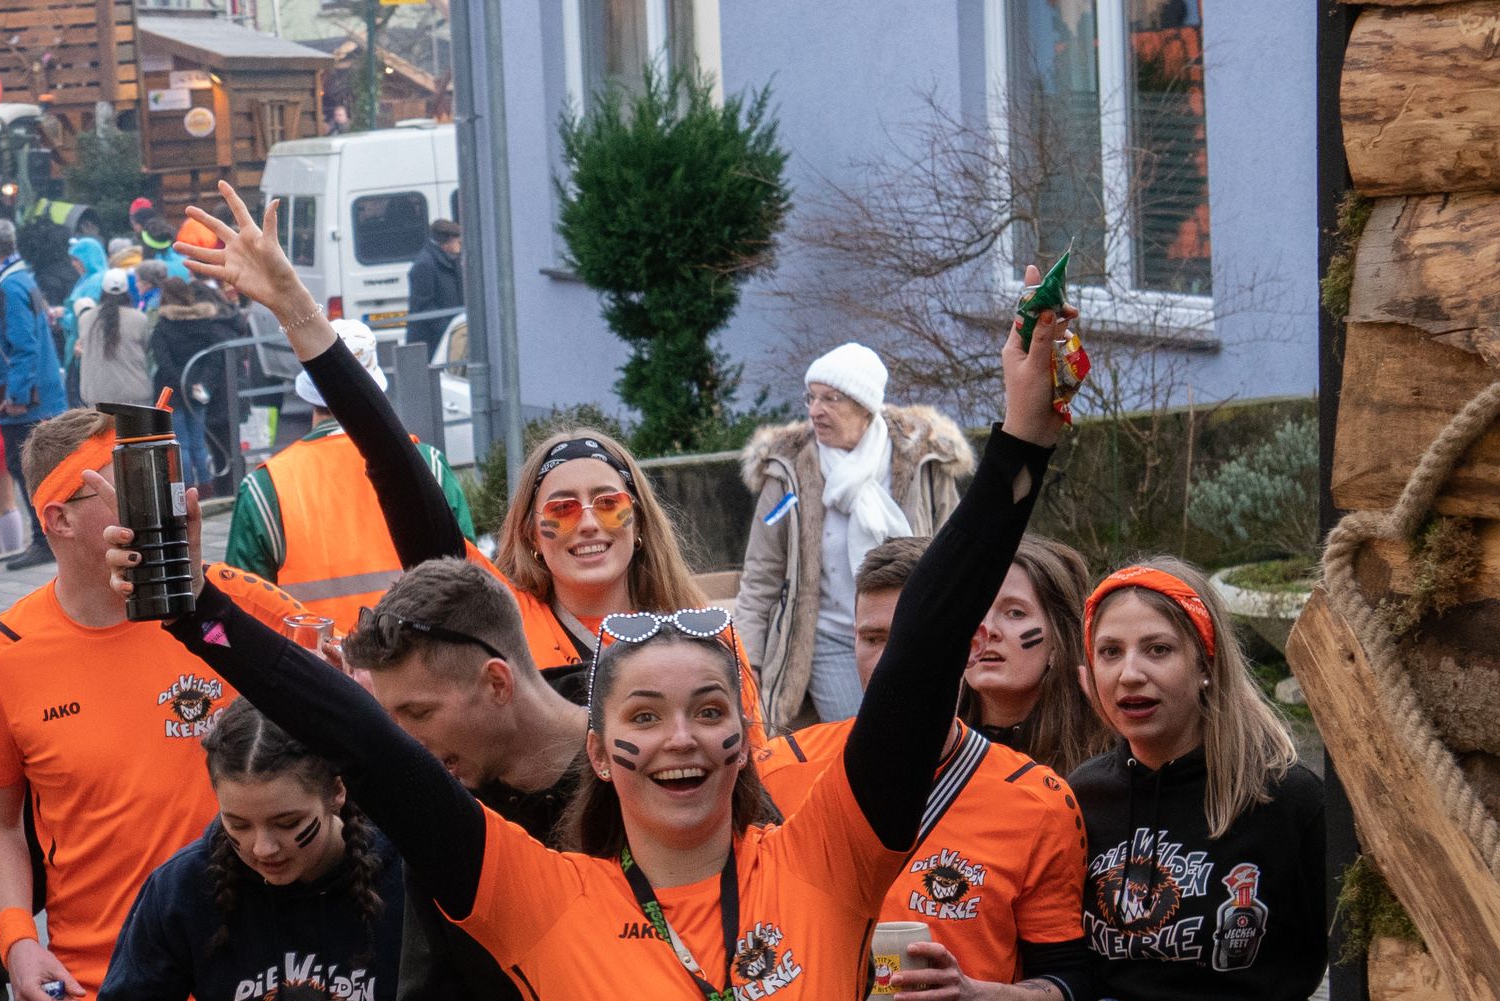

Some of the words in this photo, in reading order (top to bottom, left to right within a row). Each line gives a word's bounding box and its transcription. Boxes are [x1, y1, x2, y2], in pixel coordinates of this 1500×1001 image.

[43, 702, 81, 722] JAKO
[909, 890, 982, 921] KERLE
[1083, 911, 1205, 962] KERLE
[1224, 928, 1257, 940] JECKEN
[1229, 939, 1250, 948] FETT
